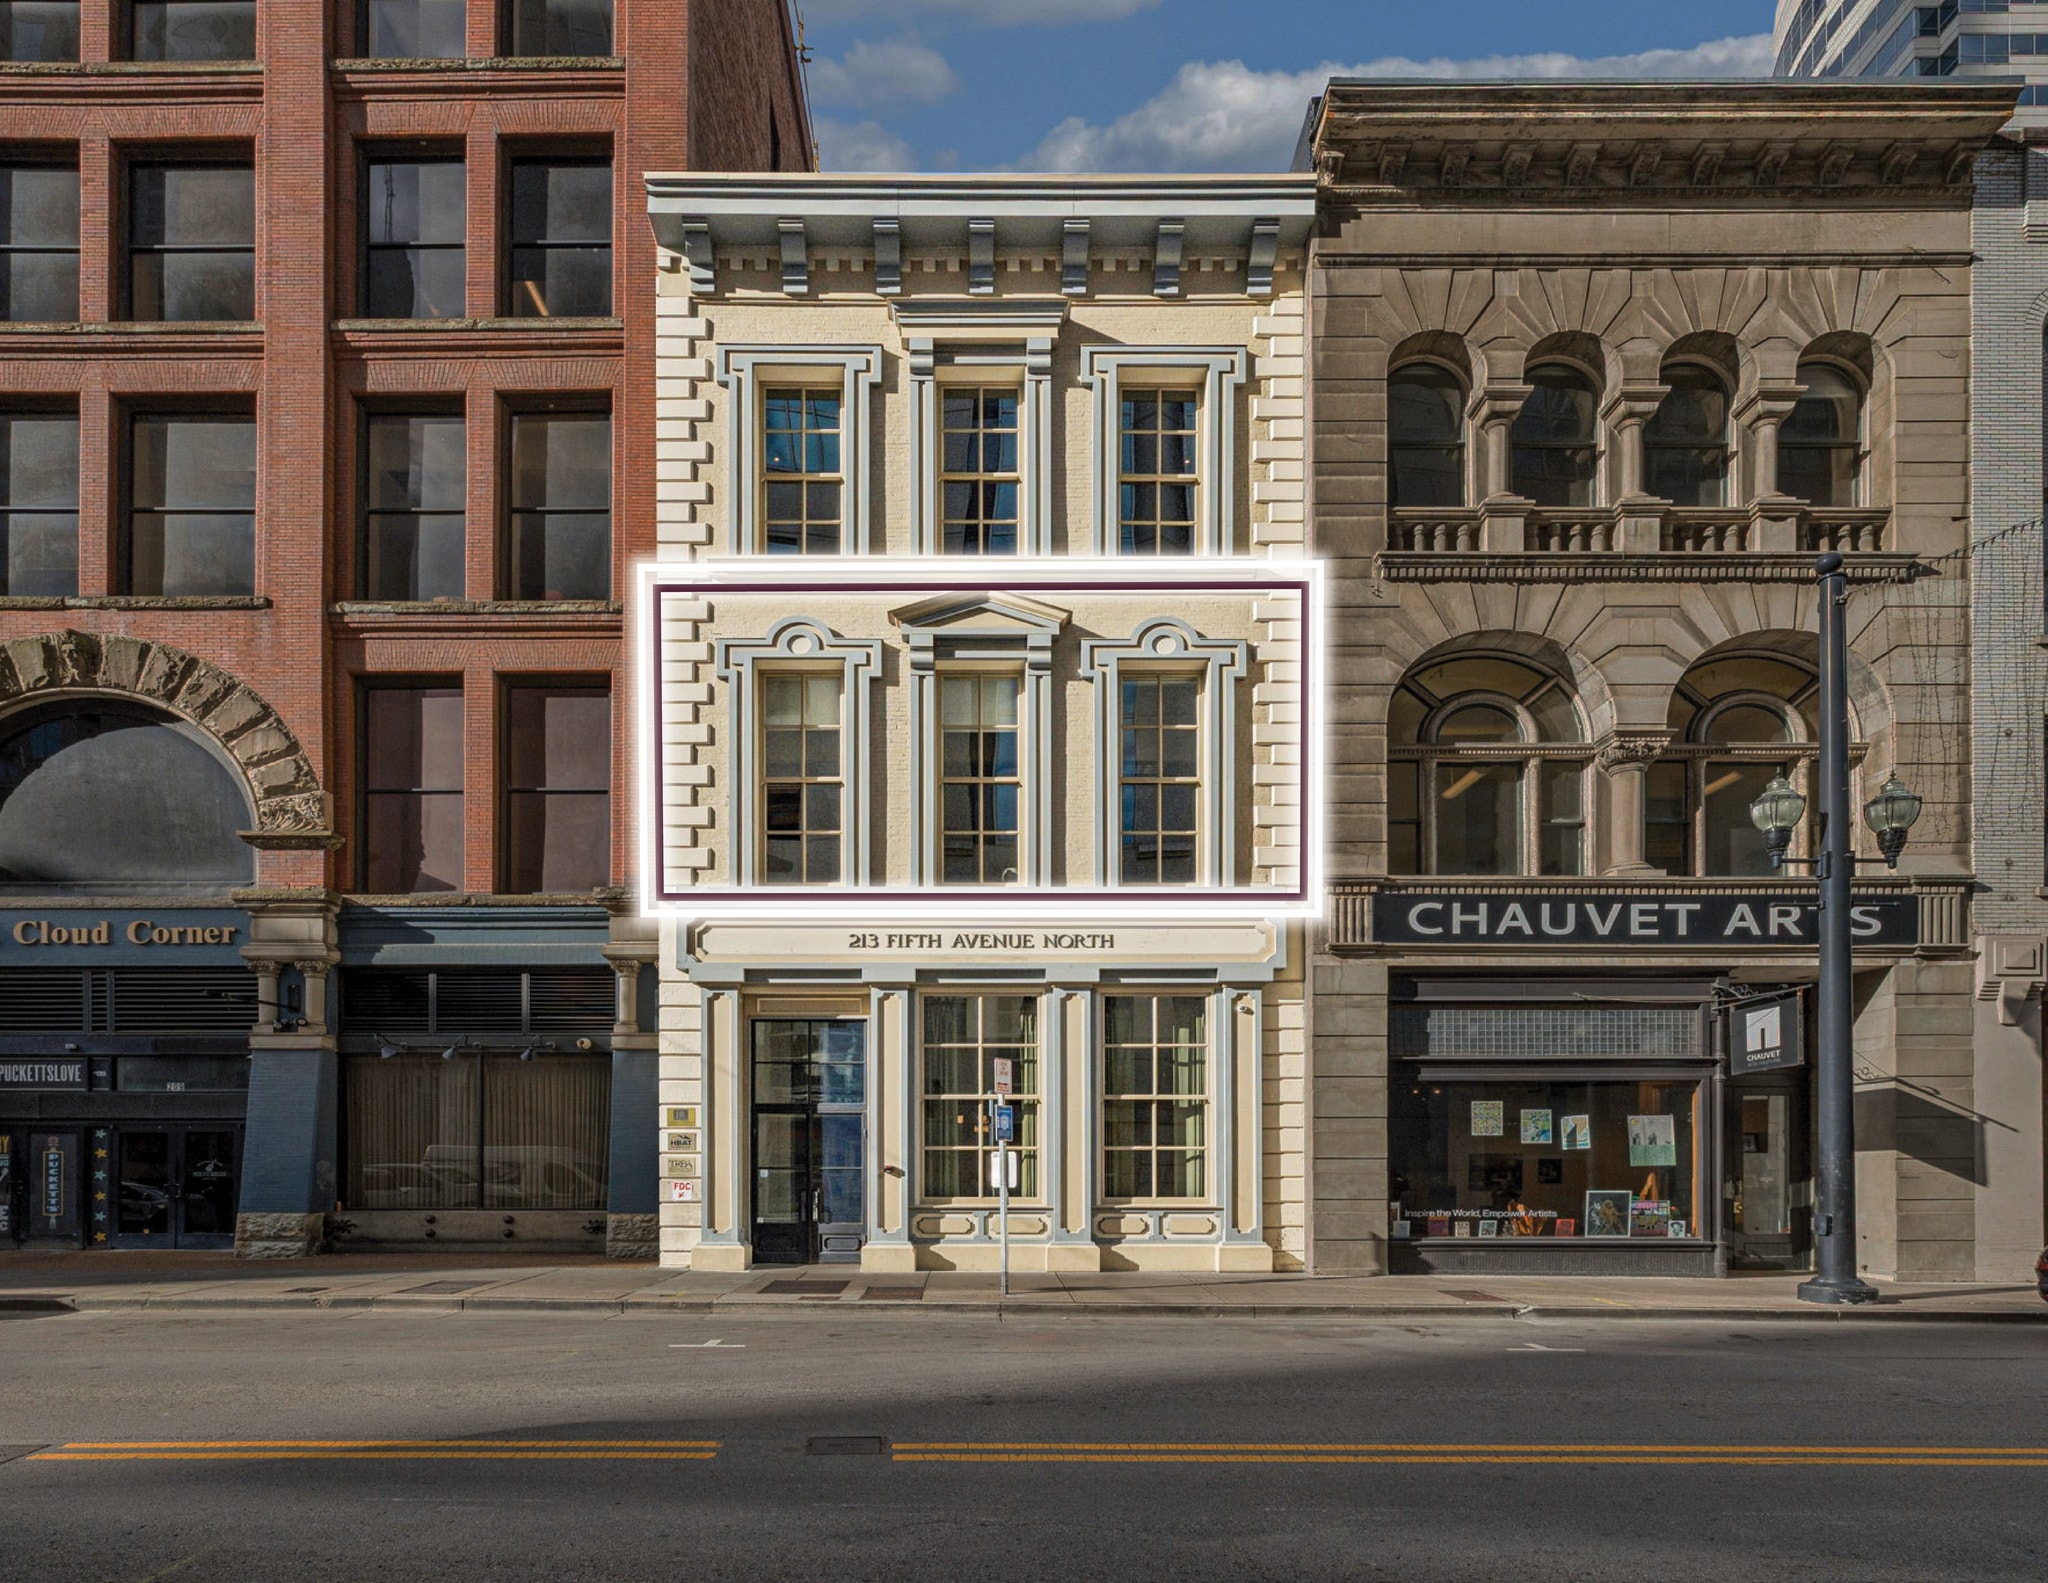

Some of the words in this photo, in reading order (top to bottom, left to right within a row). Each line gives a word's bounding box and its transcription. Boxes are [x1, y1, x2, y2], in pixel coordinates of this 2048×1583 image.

[1407, 902, 1701, 935] CHAUVET
[1723, 903, 1883, 936] ARS
[13, 920, 110, 944] Cloud
[126, 920, 236, 944] Corner
[849, 934, 879, 948] 213
[887, 934, 942, 948] FIFTH
[951, 934, 1035, 948] AVENUE
[1043, 934, 1115, 948] NORTH
[1746, 1049, 1781, 1062] CHAUVET
[673, 1183, 692, 1191] FDC
[1404, 1210, 1435, 1219] Inspire
[1452, 1210, 1482, 1218] World,
[1483, 1210, 1525, 1219] Empower
[1528, 1210, 1558, 1218] Artists
